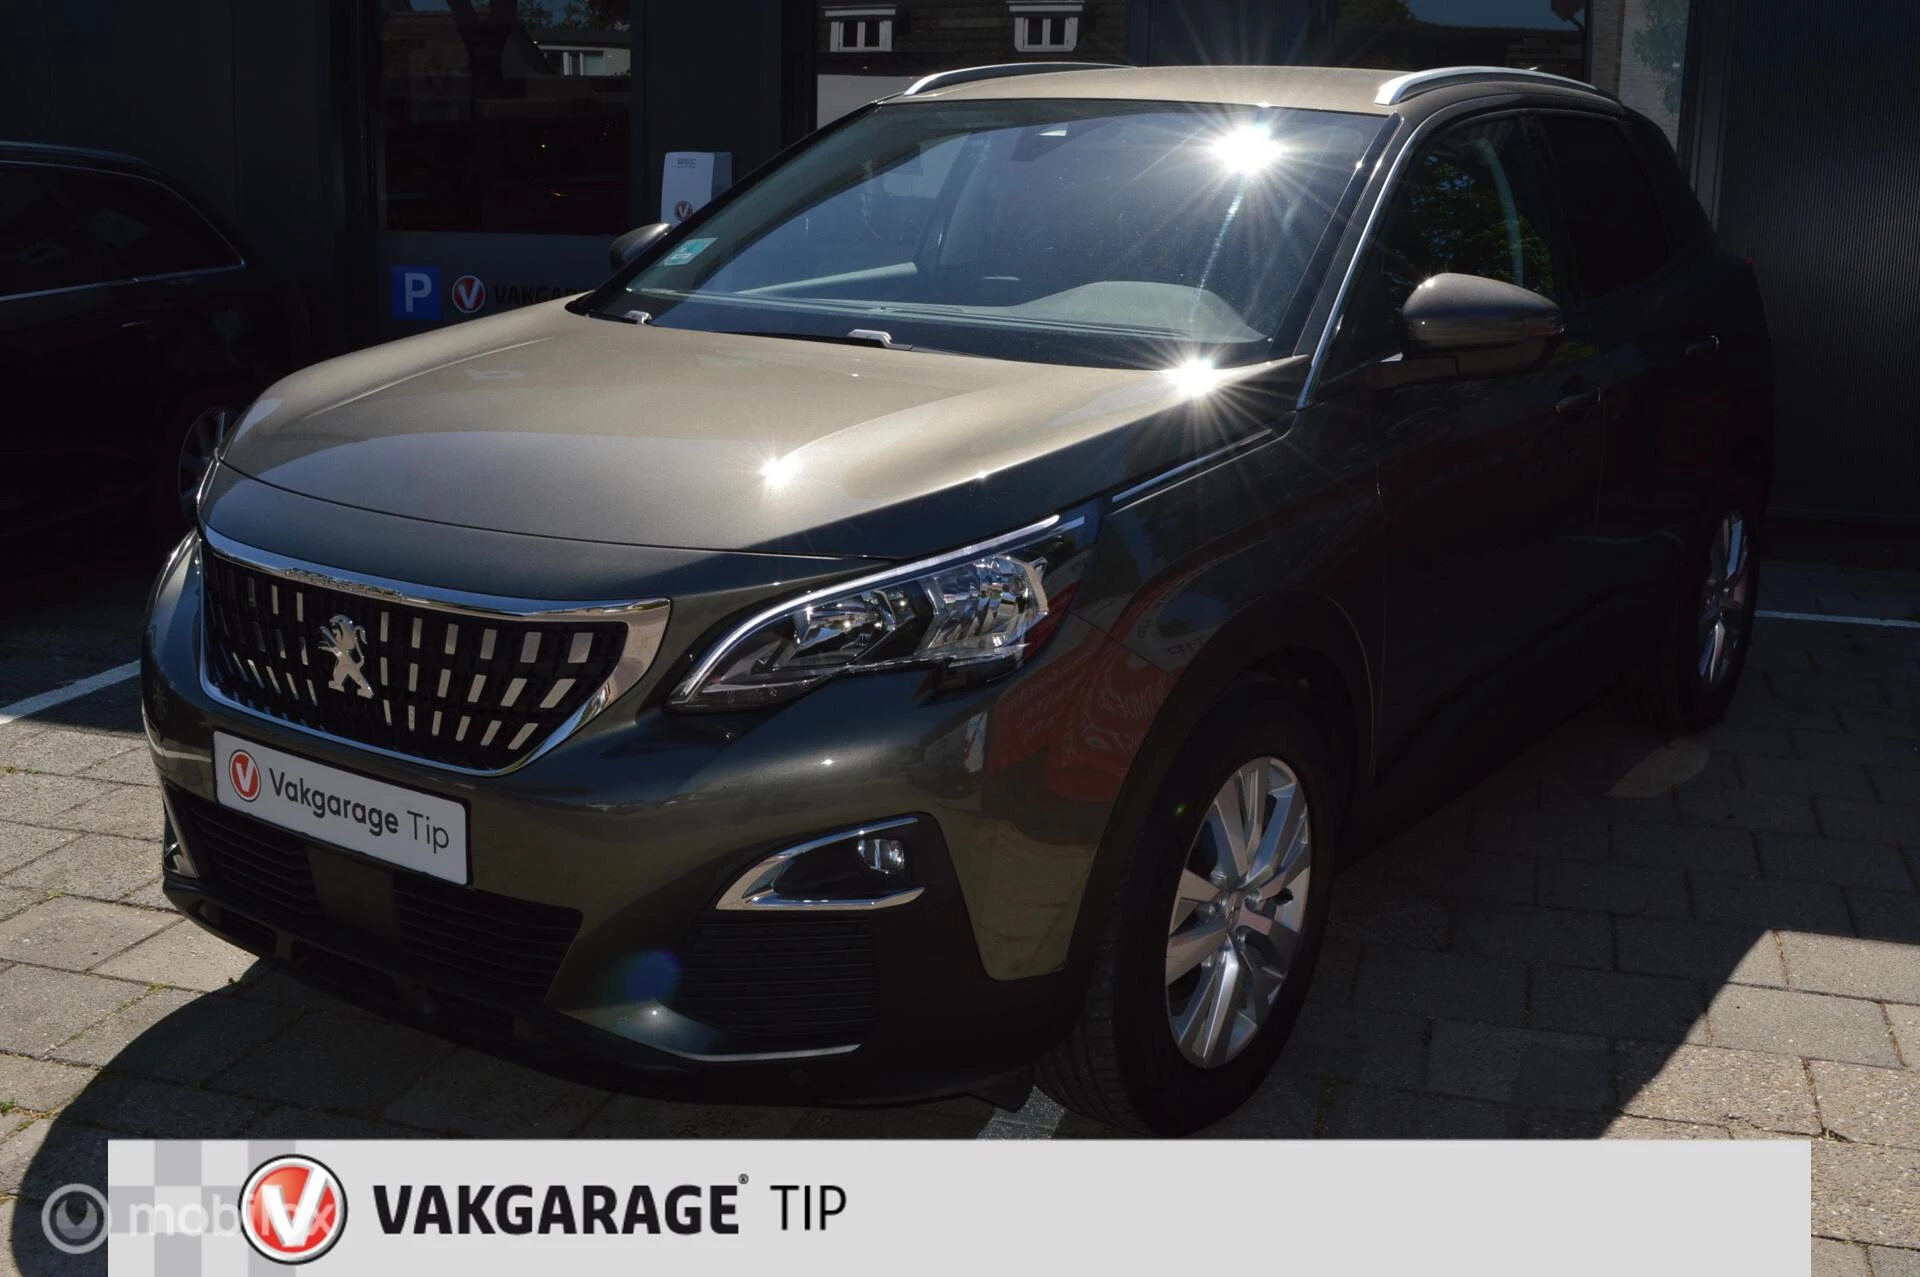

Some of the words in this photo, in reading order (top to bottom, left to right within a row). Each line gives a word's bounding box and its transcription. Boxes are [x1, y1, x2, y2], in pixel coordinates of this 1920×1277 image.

[404, 272, 432, 312] P
[269, 768, 399, 837] Vakgarage
[407, 810, 450, 854] Tip
